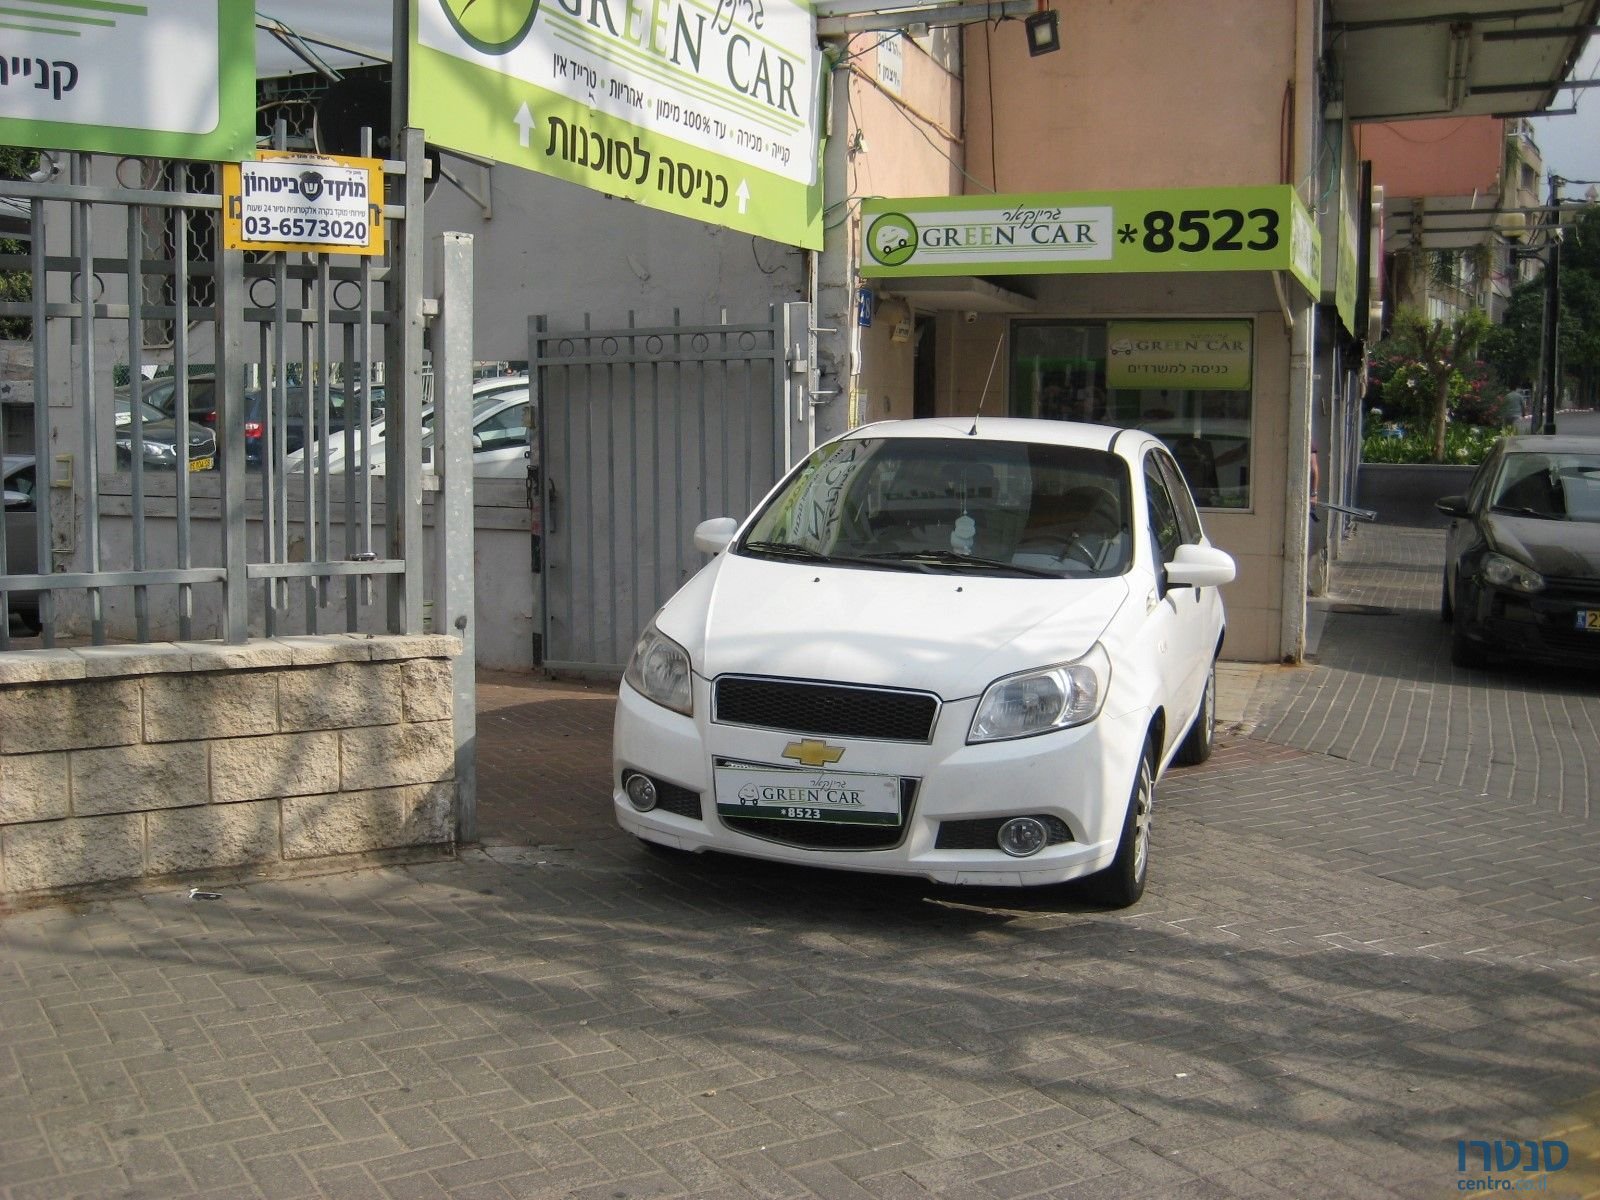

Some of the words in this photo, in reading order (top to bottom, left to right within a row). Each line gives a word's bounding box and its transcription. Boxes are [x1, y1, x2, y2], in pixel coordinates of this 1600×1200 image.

[553, 52, 568, 78] אין
[558, 0, 706, 74] REEN
[726, 34, 800, 117] CAR
[570, 60, 597, 89] טרייד
[609, 79, 644, 109] אחריות
[656, 98, 680, 122] מימון
[683, 109, 711, 134] 100%
[714, 120, 727, 139] עד
[736, 129, 763, 153] מכירה
[545, 115, 651, 185] לסוכנות
[771, 141, 791, 167] קנייה
[244, 171, 299, 198] ביטחון
[323, 177, 366, 201] מוקד
[658, 155, 729, 209] כניסה
[246, 204, 263, 212] שעות
[263, 204, 272, 212] 24
[287, 206, 317, 216] אלקטרונית
[318, 207, 334, 217] בקרה
[245, 216, 367, 240] 03-6573020
[922, 224, 1015, 248] GREEN
[1030, 223, 1096, 245] CAR
[1136, 340, 1199, 351] GREEN
[1206, 340, 1244, 351] CAR
[1127, 362, 1186, 374] למשרדים
[1191, 364, 1228, 374] כניסה
[762, 787, 819, 802] GREEN
[826, 790, 862, 804] CAR
